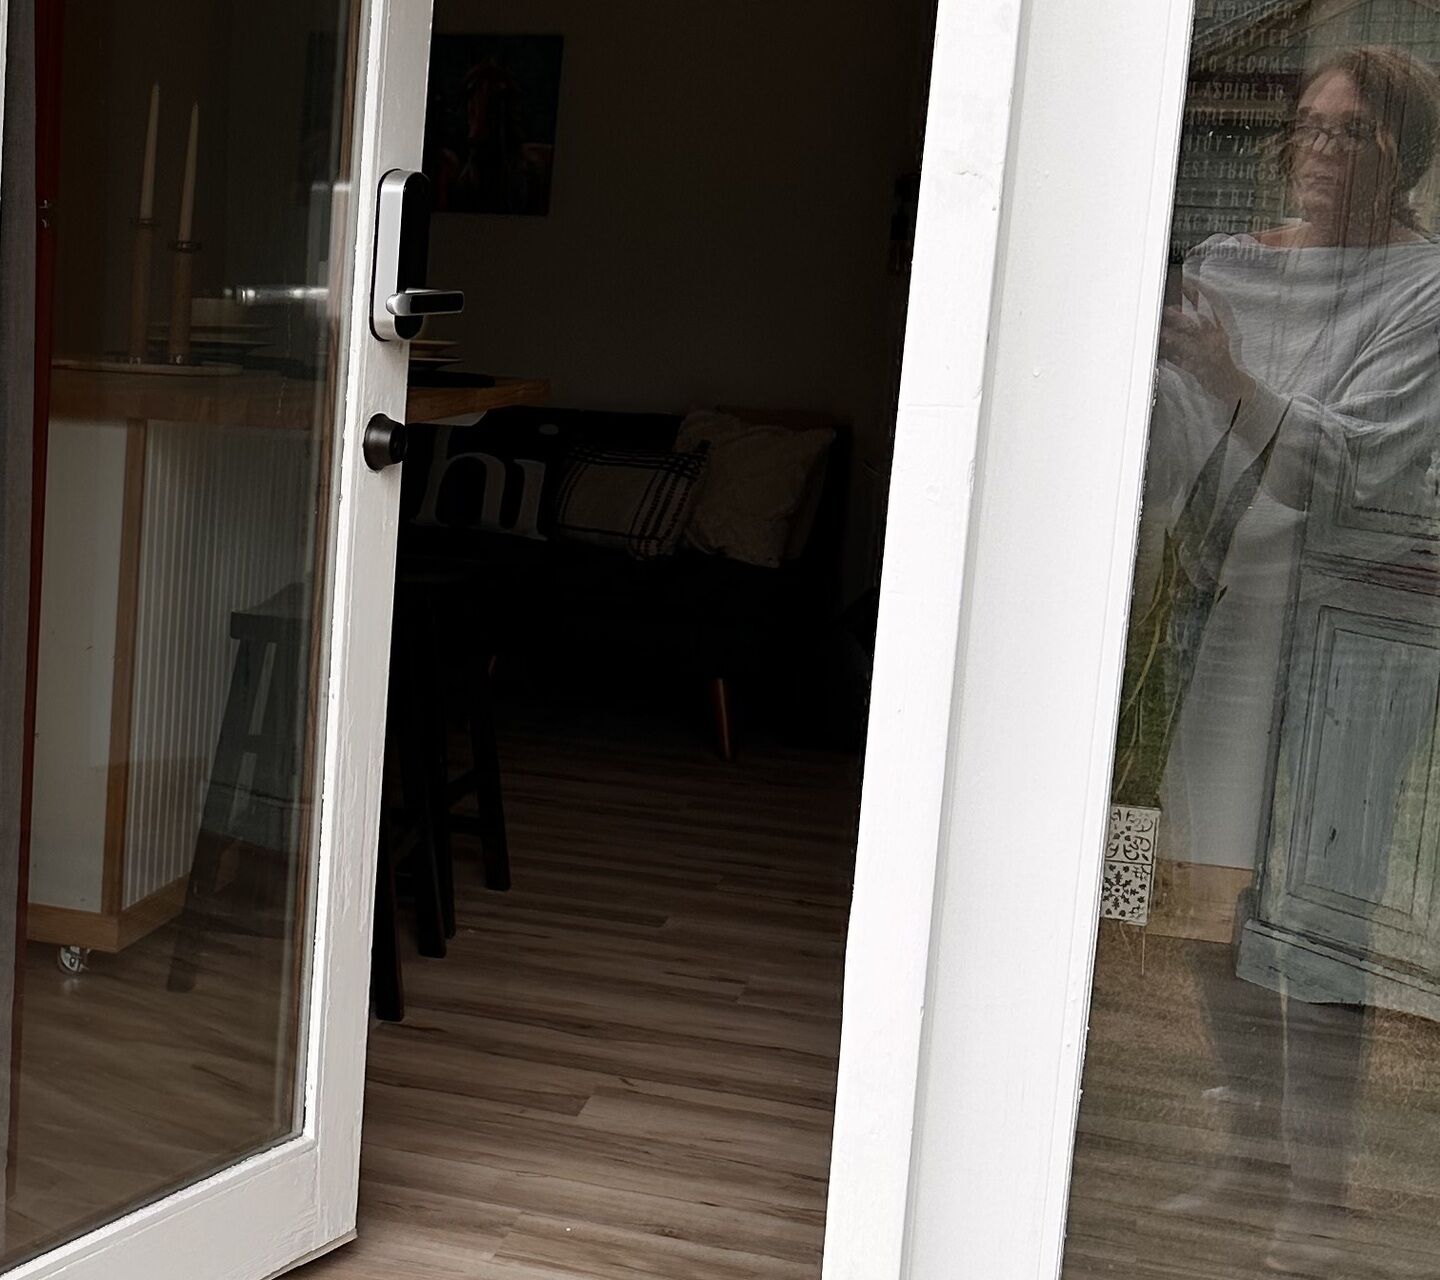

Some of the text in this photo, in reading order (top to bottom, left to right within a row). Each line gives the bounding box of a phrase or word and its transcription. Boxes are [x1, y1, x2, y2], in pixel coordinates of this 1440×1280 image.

[1224, 55, 1291, 75] BECOME
[1231, 107, 1283, 128] THINGS
[1181, 133, 1223, 153] NJOY
[1180, 159, 1279, 182] EST THINGS
